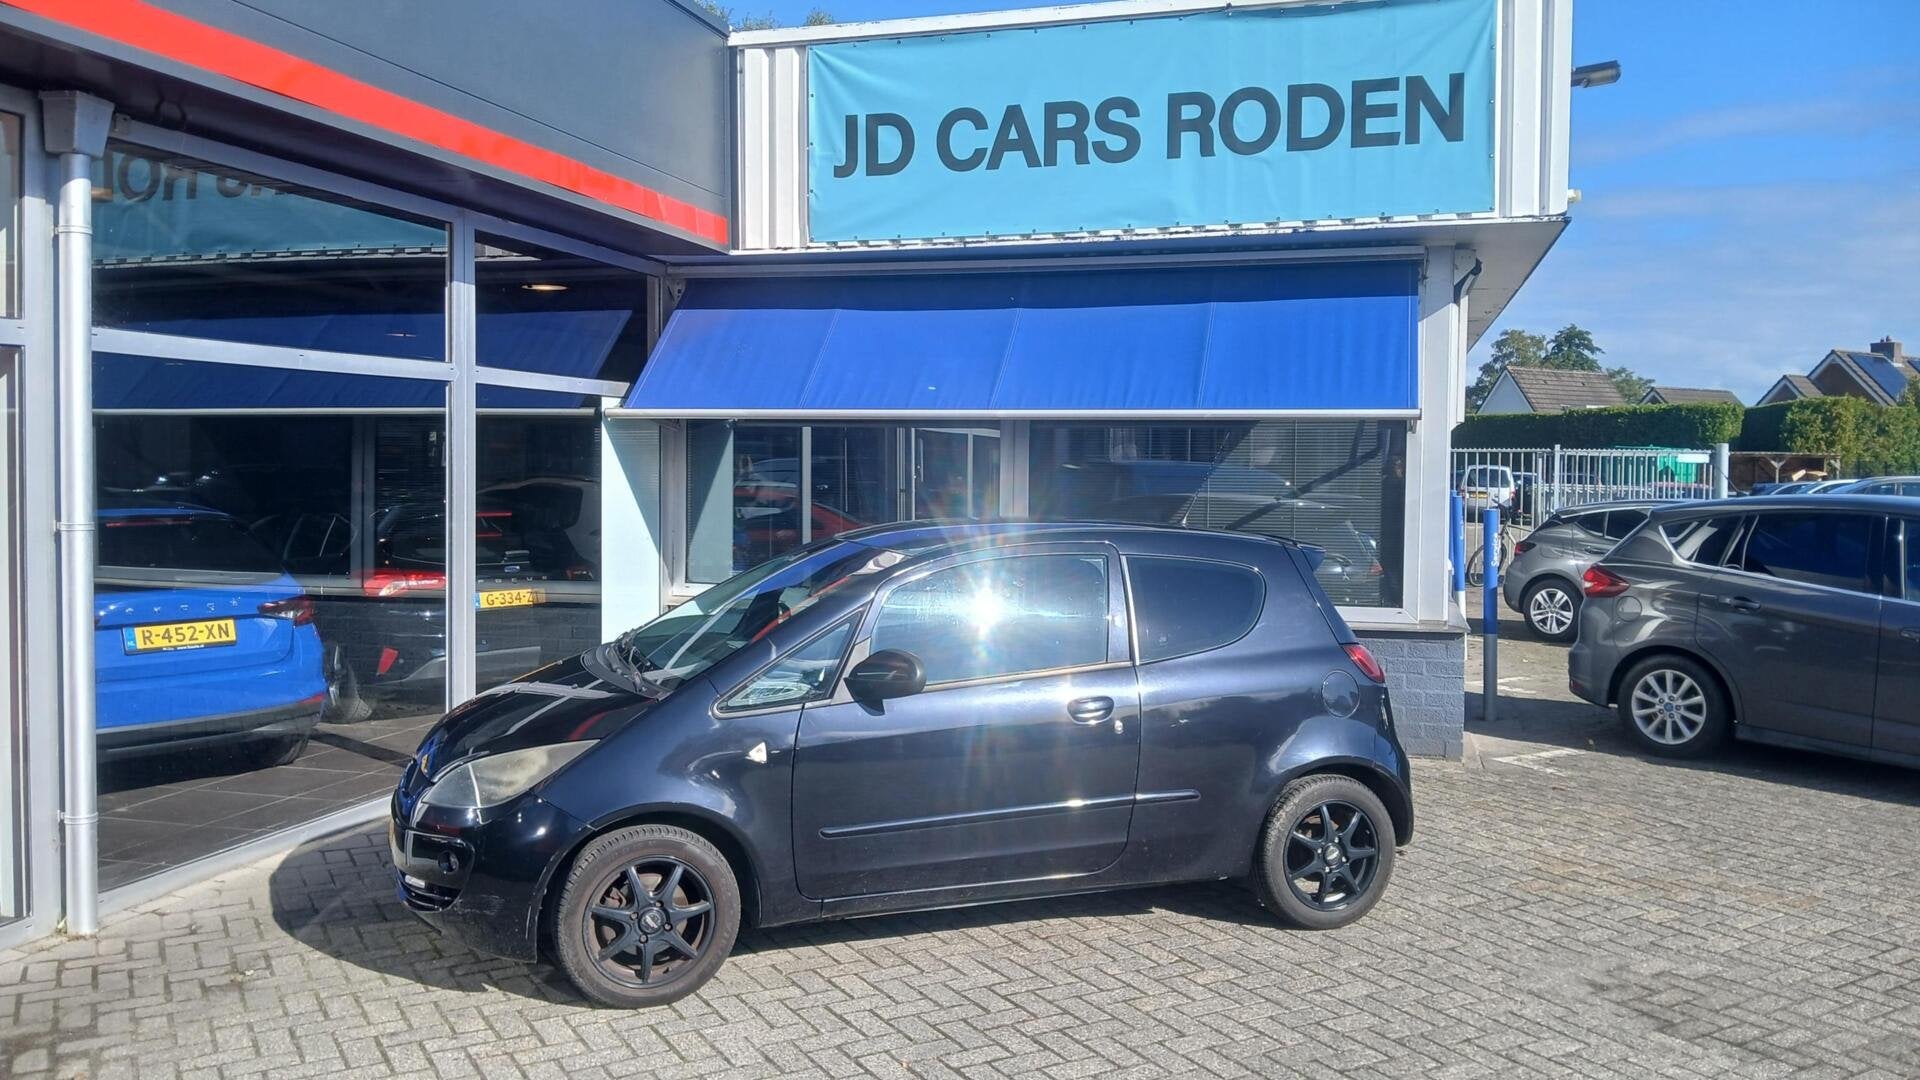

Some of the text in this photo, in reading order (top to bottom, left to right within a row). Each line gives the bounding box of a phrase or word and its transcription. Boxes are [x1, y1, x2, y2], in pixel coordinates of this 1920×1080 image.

[833, 72, 1465, 179] JD CARS RODEN
[142, 622, 230, 646] R-452-XN
